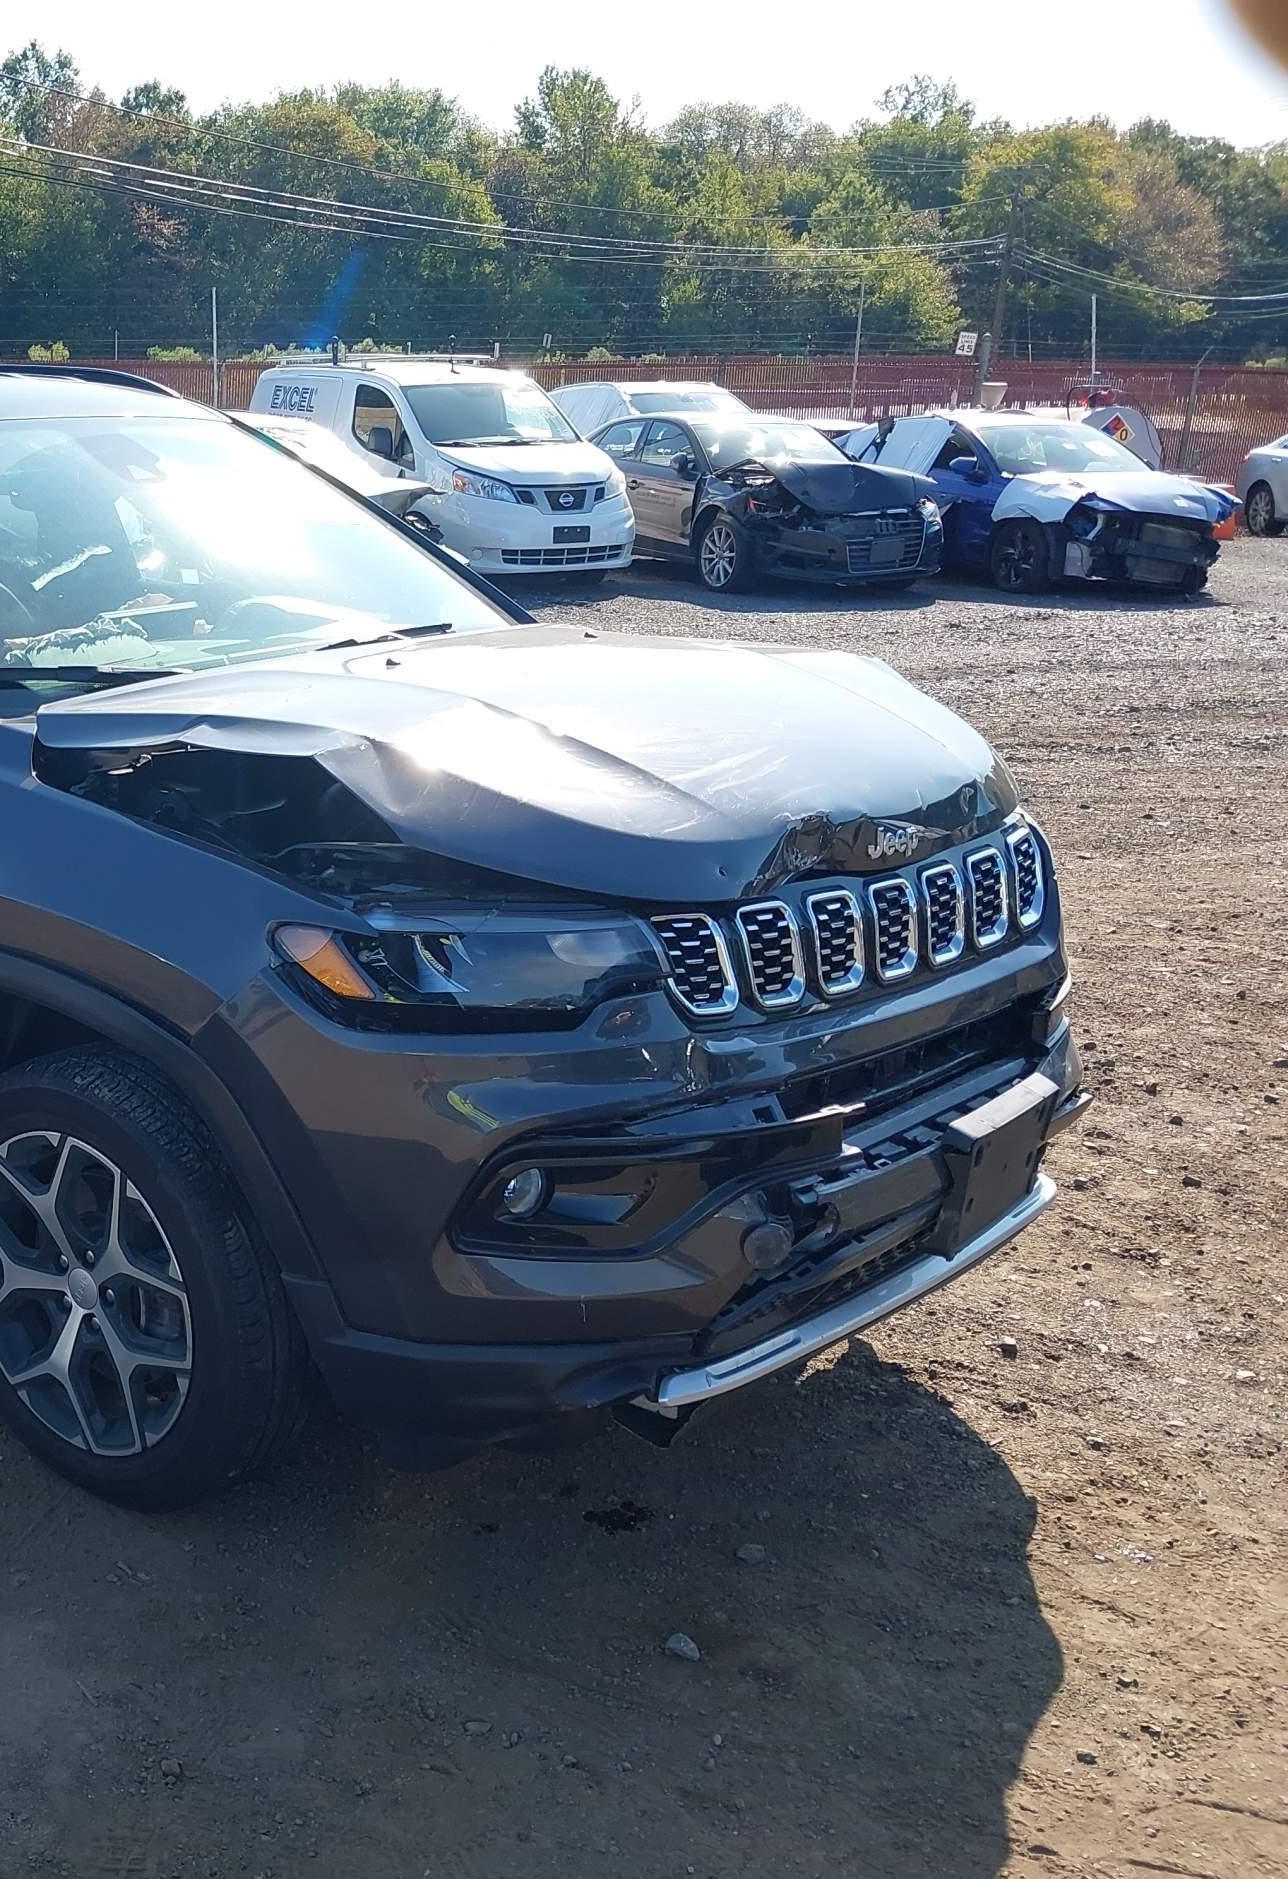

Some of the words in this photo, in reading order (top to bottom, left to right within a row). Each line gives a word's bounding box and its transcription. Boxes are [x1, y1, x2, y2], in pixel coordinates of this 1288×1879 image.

[958, 344, 973, 353] 45
[270, 385, 315, 412] EXCEL
[1120, 428, 1128, 441] 0
[867, 826, 919, 860] Jeep
